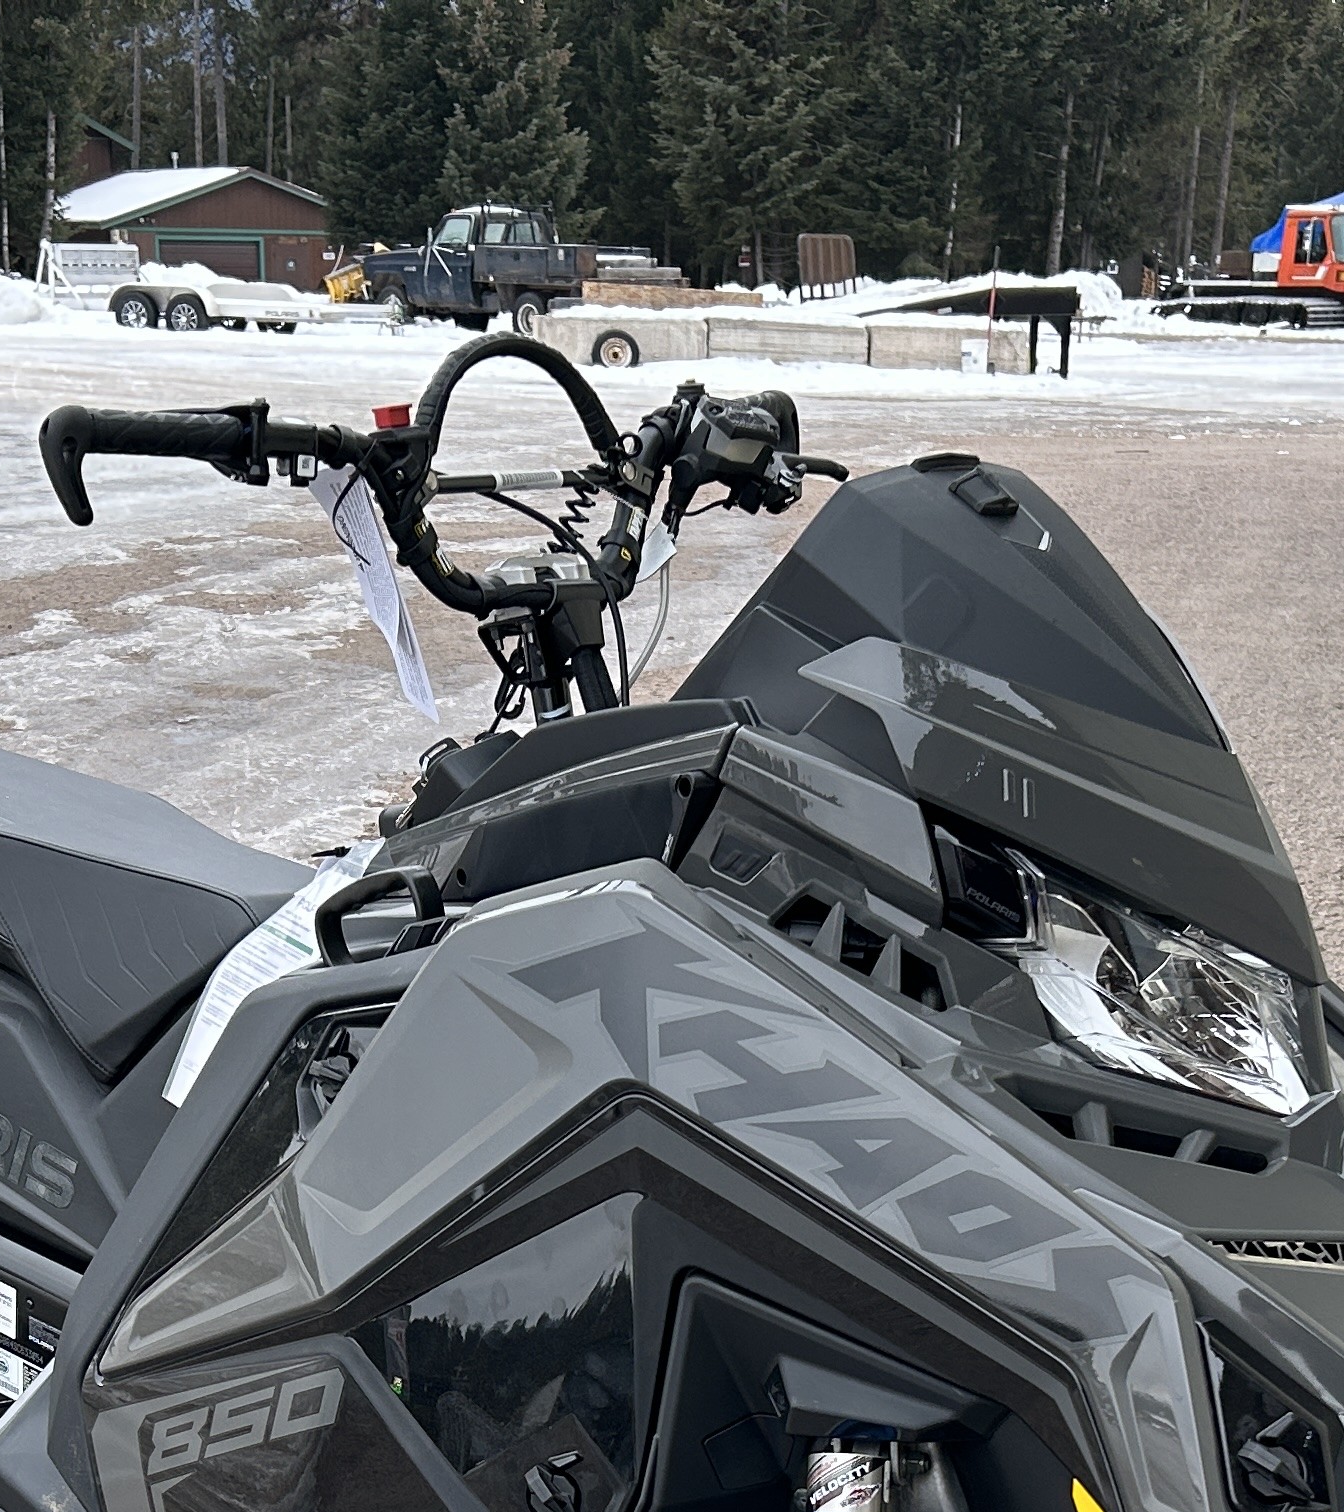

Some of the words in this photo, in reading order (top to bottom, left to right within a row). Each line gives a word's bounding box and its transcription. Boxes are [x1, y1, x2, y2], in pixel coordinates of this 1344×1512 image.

[966, 886, 1021, 923] POLARIS
[508, 915, 1159, 1343] KHAOS
[147, 1367, 346, 1476] 850
[809, 1461, 871, 1505] VELOCITY
